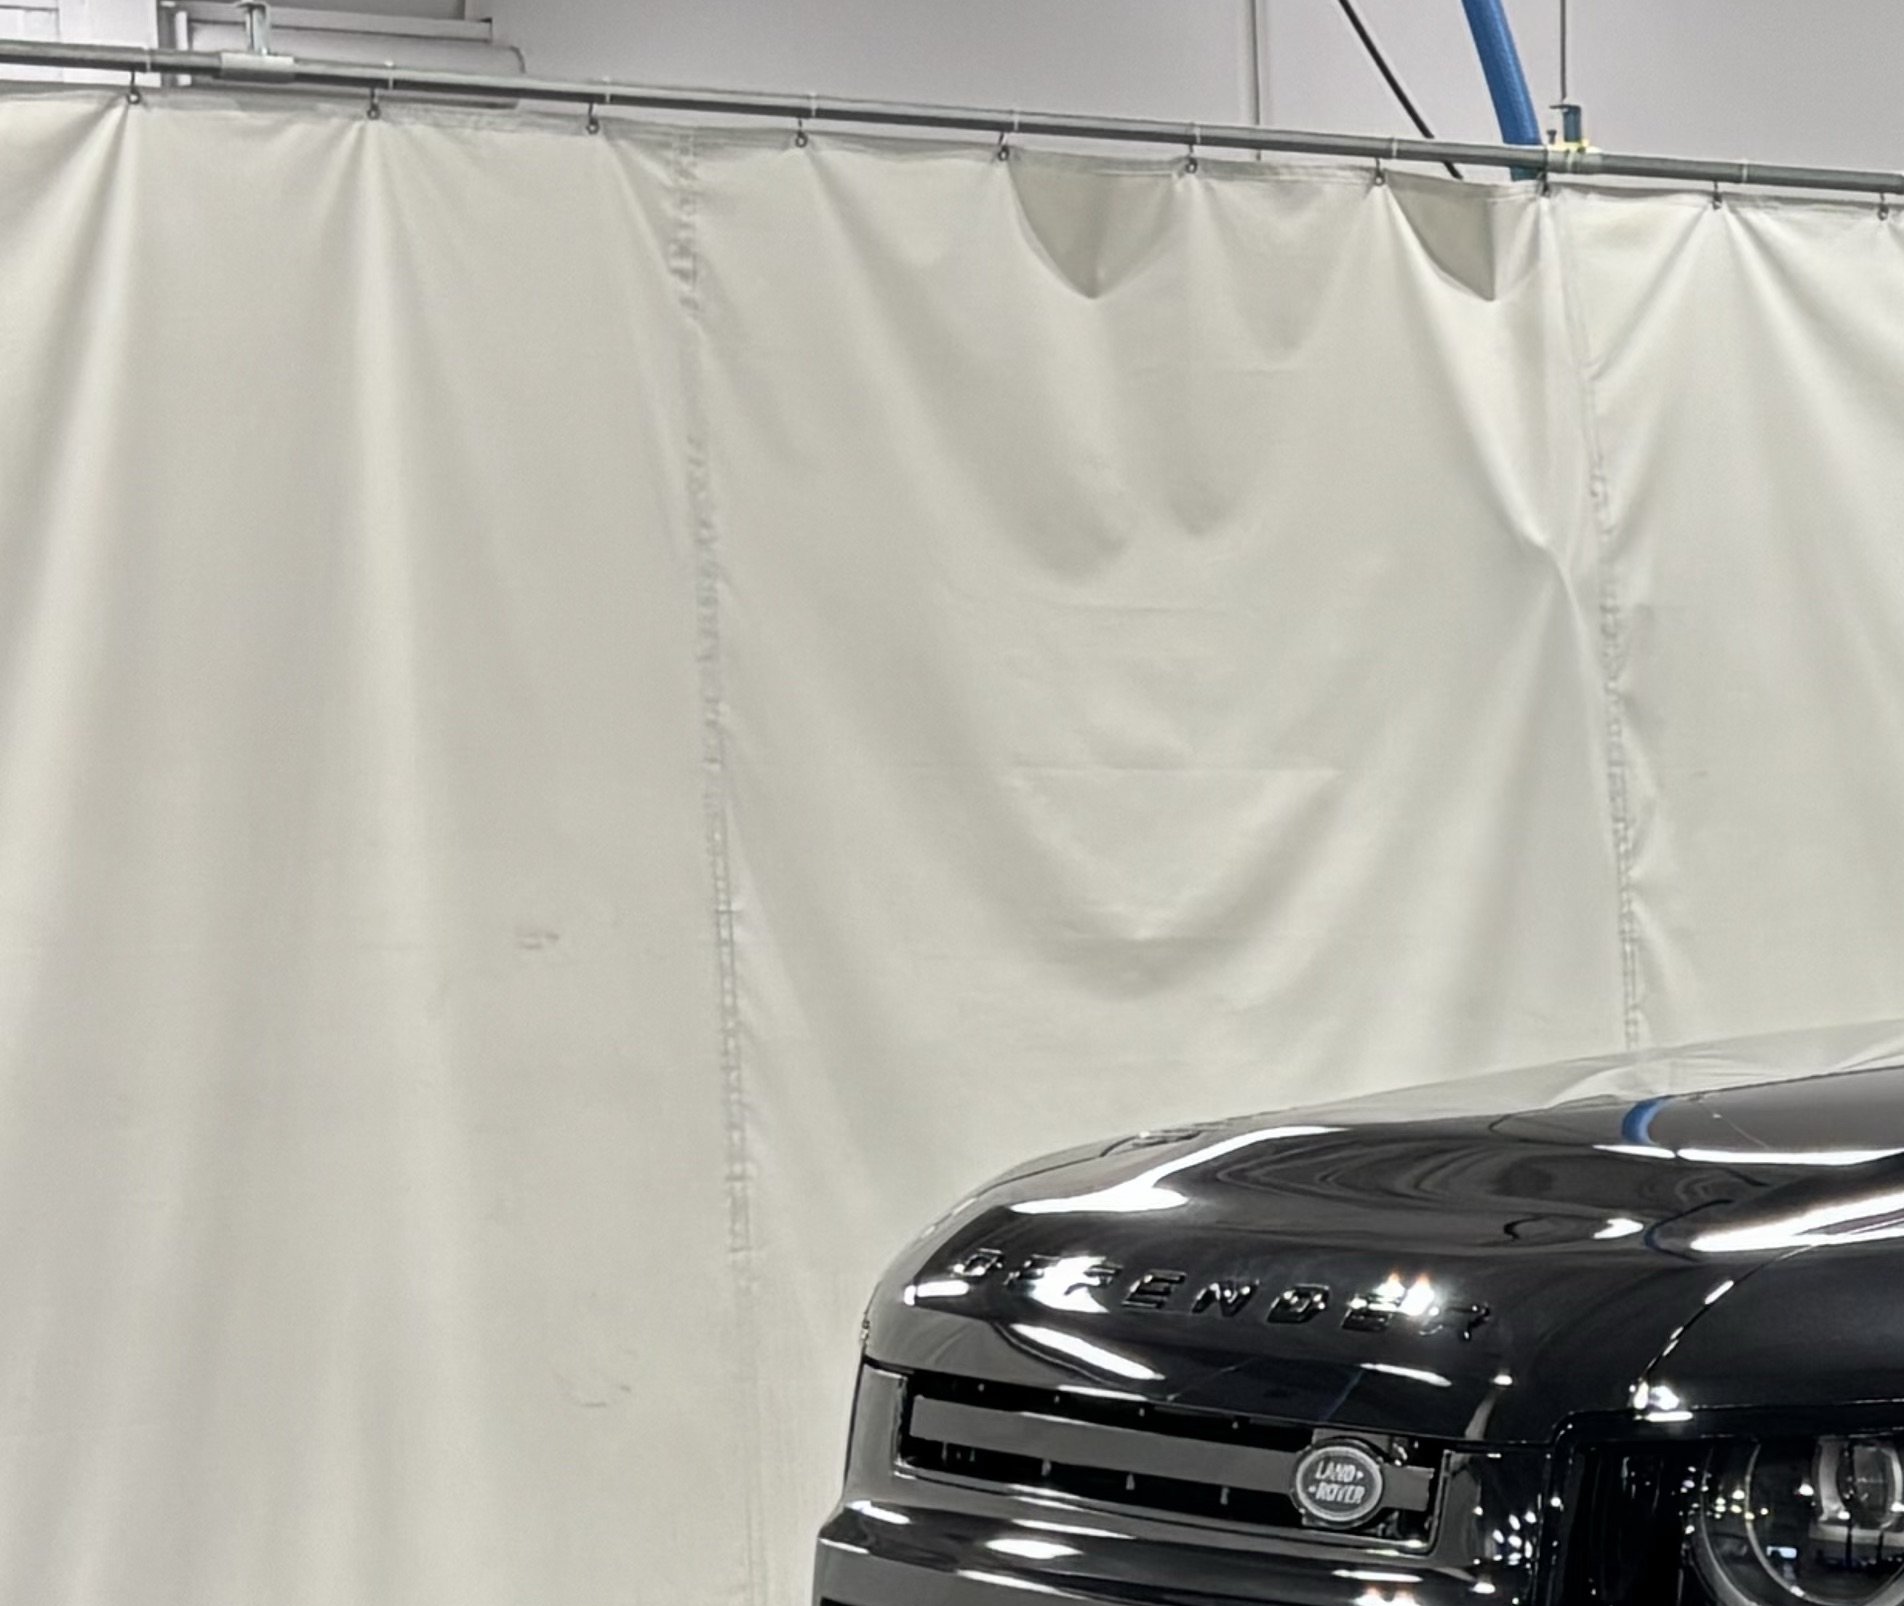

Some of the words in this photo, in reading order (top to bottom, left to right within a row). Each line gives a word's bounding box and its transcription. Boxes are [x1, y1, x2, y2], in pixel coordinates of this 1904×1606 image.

[951, 1247, 1490, 1340] DEFENDER
[1315, 1460, 1357, 1483] LAND
[1315, 1482, 1366, 1504] ROVER
